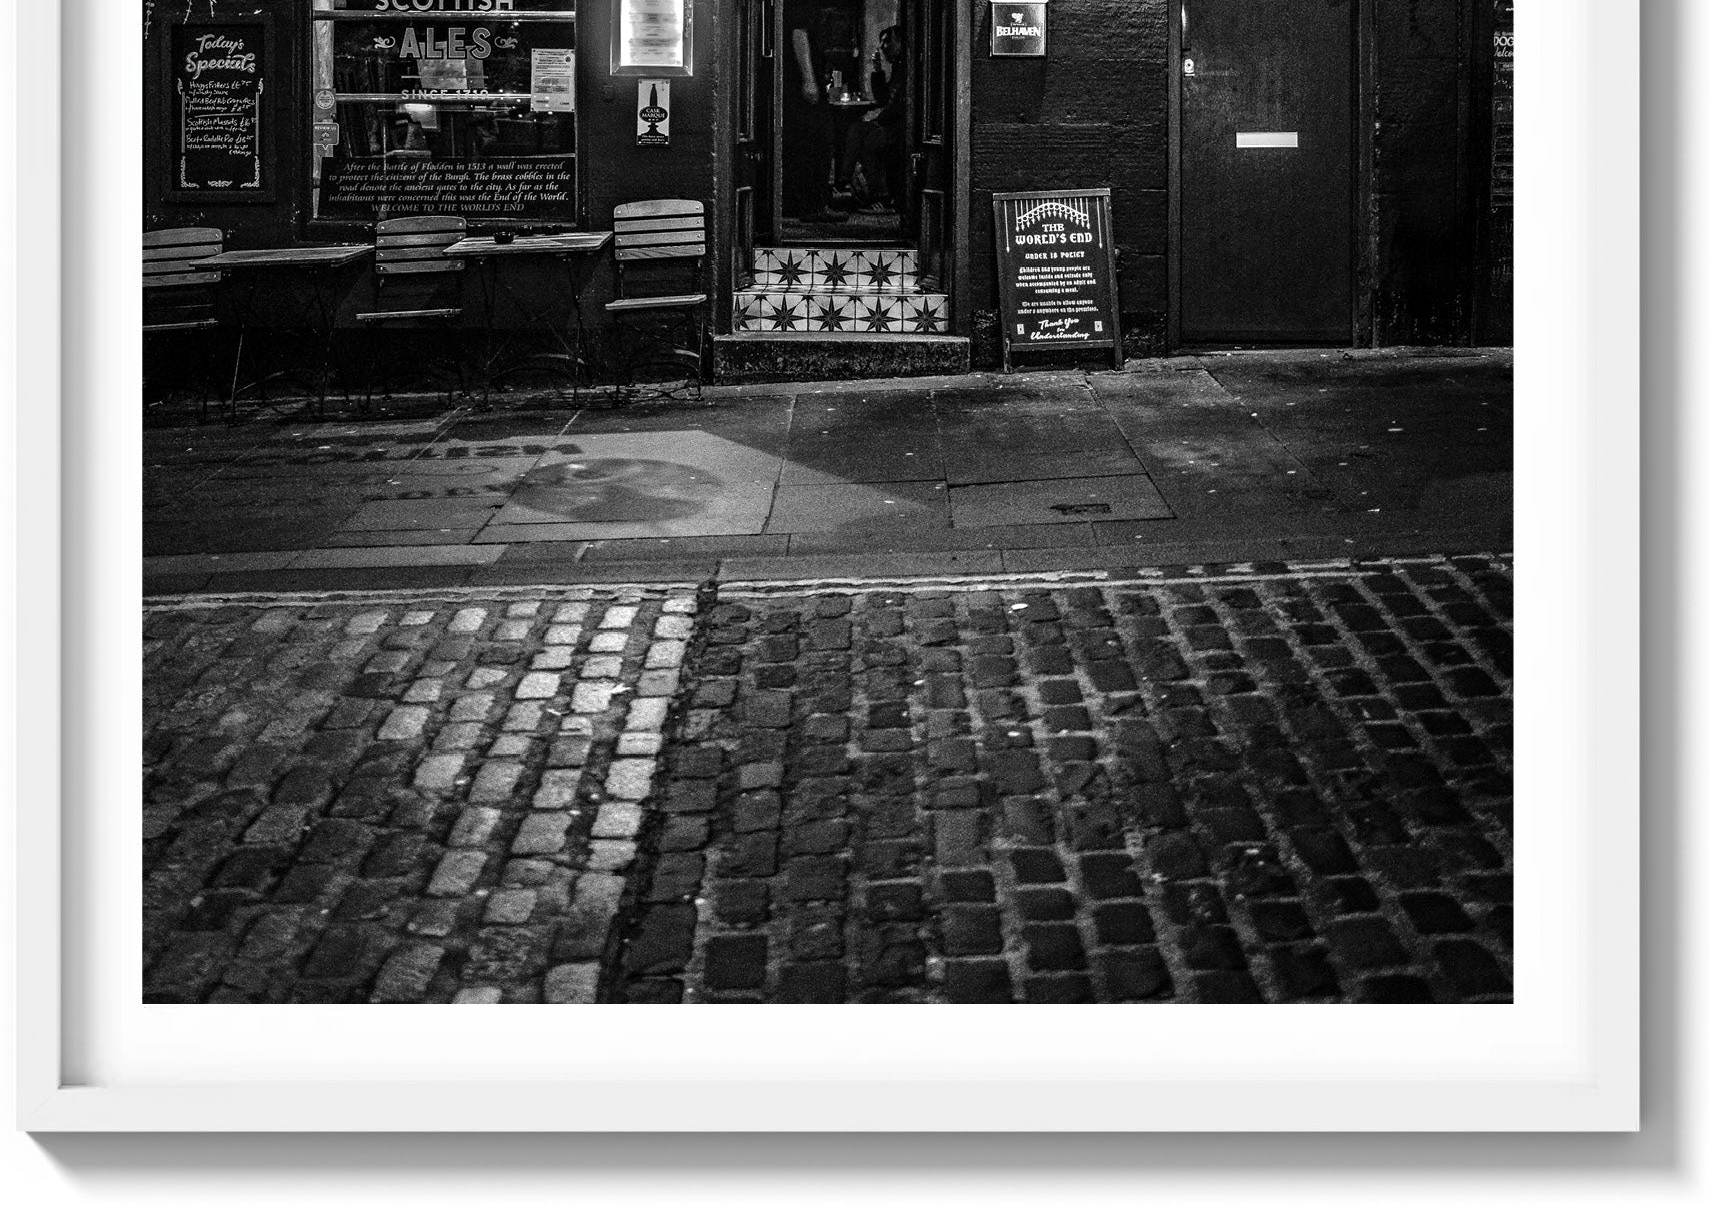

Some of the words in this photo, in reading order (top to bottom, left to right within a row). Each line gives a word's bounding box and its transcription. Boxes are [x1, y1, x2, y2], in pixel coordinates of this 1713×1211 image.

[996, 25, 1042, 36] BELHAVEN
[196, 34, 245, 54] Today's
[399, 27, 492, 59] ALES
[186, 51, 256, 80] Specials
[401, 89, 448, 100] SINCE
[343, 162, 365, 174] After
[367, 162, 381, 171] the
[410, 161, 420, 174] of
[422, 161, 453, 171] Flodden
[456, 162, 465, 171] in
[467, 162, 486, 170] 1513
[497, 161, 516, 170] wall
[535, 161, 565, 170] erected
[336, 174, 368, 184] protect
[371, 172, 385, 181] the
[418, 172, 429, 185] of
[429, 172, 442, 181] the
[474, 171, 490, 180] The
[491, 171, 513, 180] brass
[515, 171, 543, 180] cobbles
[545, 172, 555, 180] in
[556, 171, 571, 180] the
[340, 182, 359, 191] road
[360, 182, 387, 191] denote
[388, 182, 402, 191] the
[435, 184, 457, 194] gates
[470, 182, 484, 191] the
[505, 183, 517, 191] As
[515, 181, 532, 194] far
[545, 181, 559, 190] the
[328, 192, 375, 201] inhabitants
[398, 192, 440, 201] concerned
[441, 192, 457, 201] this
[478, 192, 492, 201] the
[494, 192, 512, 201] End
[512, 192, 522, 203] of
[523, 192, 538, 201] the
[540, 192, 569, 201] World.
[371, 203, 420, 212] WELCOME
[422, 203, 435, 212] TO
[438, 203, 458, 211] THE
[460, 203, 501, 211] WORLD'S
[503, 203, 525, 211] END
[1042, 224, 1065, 232] THE
[1015, 233, 1067, 245] WORLD'S
[1069, 232, 1093, 243] END
[1038, 319, 1064, 330] Thank
[1064, 317, 1080, 329] You
[1030, 331, 1090, 340] Understanding
